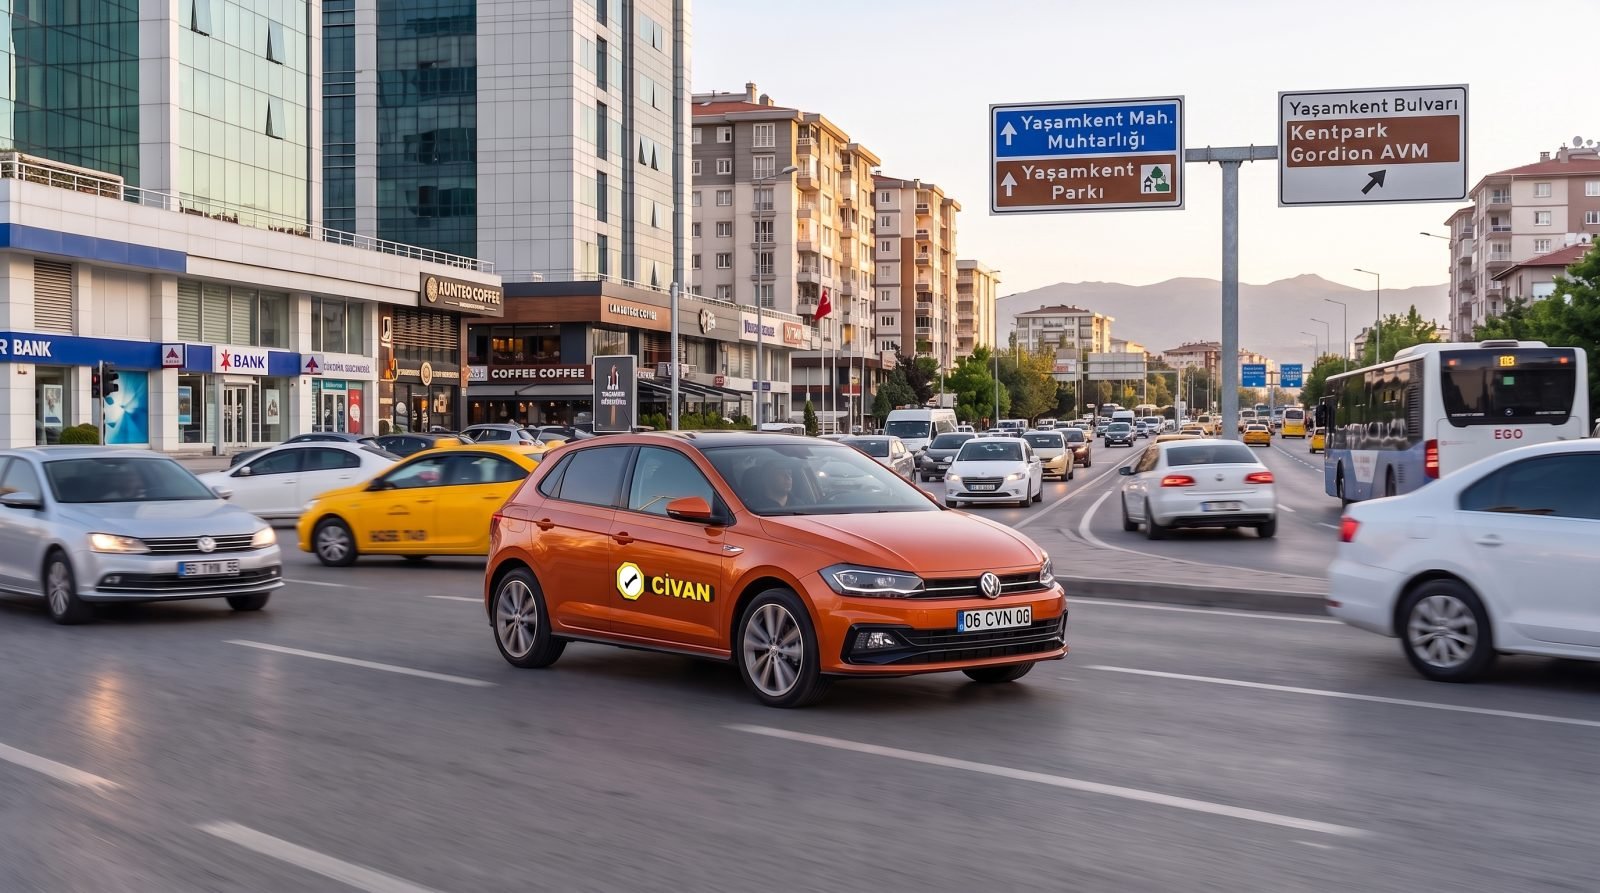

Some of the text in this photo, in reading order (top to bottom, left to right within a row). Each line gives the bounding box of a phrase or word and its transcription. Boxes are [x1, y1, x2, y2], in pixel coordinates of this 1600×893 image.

[1290, 97, 1458, 117] Yaşamkent Bulvarı
[1021, 110, 1174, 132] Yaşamkent Mah.
[1048, 131, 1145, 150] Muhtarlığı
[1291, 123, 1388, 143] Kentpark
[1291, 143, 1428, 162] Gordion AVM
[1022, 162, 1134, 182] Yaşamkent
[1052, 185, 1104, 200] Parkı
[473, 287, 500, 305] COFFEE
[13, 339, 52, 357] BANK
[233, 354, 265, 369] BANK
[491, 368, 537, 379] COFFEE
[539, 368, 585, 379] COFFEE
[1494, 429, 1523, 440] EGO
[651, 573, 710, 602] CİVAN
[965, 613, 981, 628] 06
[985, 610, 1012, 627] CVN
